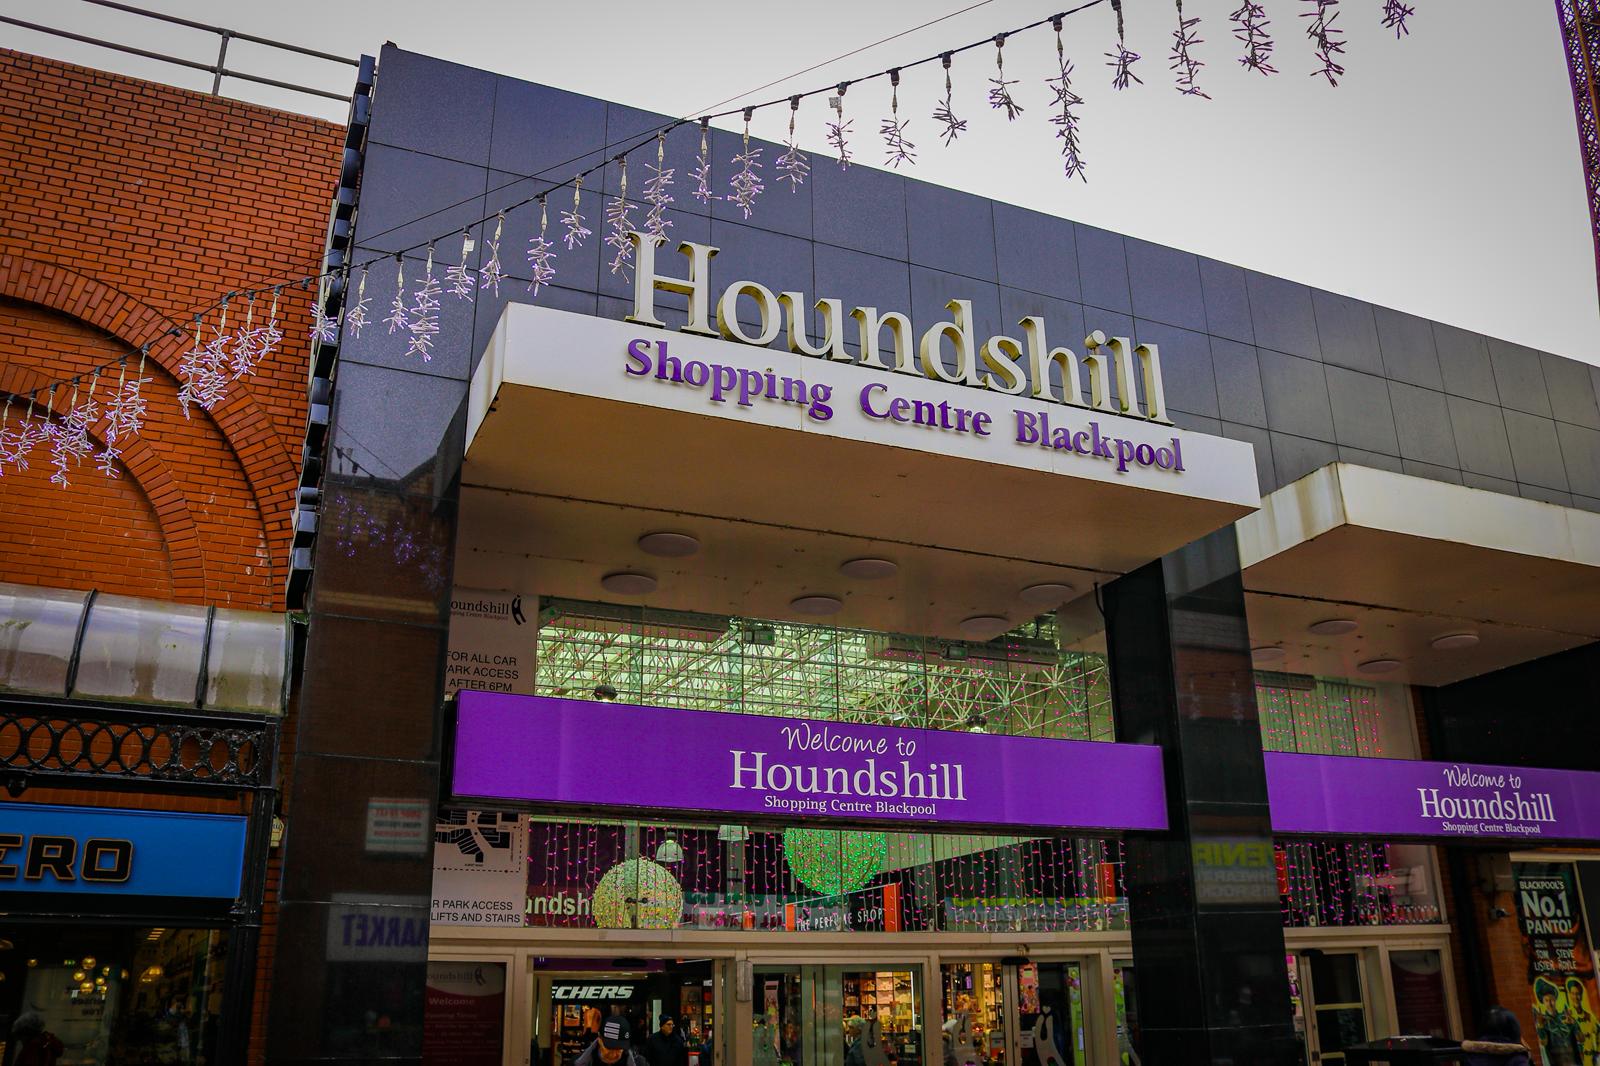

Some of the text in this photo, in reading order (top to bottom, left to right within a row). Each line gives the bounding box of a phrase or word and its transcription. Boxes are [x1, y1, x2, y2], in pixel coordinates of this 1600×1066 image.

[624, 231, 1176, 426] Houndshill
[625, 338, 1185, 474] Shopping Centre Blackpool
[451, 600, 509, 615] oundshill
[471, 653, 490, 664] ALL
[494, 656, 517, 666] CAR
[473, 668, 519, 680] ACCESS
[449, 678, 513, 692] AFTER 6PM
[781, 723, 916, 756] Welcome to
[729, 750, 967, 801] Houndshill
[1443, 765, 1522, 789] Welcome to
[764, 795, 936, 817] Shopping Centre Blackpool
[1417, 788, 1556, 822] Houndshill
[1442, 822, 1541, 836] Shopping Centre Blackpool
[1519, 880, 1565, 890] BLACKPOOL'S
[443, 900, 469, 909] PARK
[472, 901, 513, 910] ACCESS
[1521, 890, 1570, 918] No.1
[430, 912, 520, 923] LIFTS AND STAIRS
[857, 907, 883, 923] SHOP
[1525, 919, 1573, 935] PANTO!
